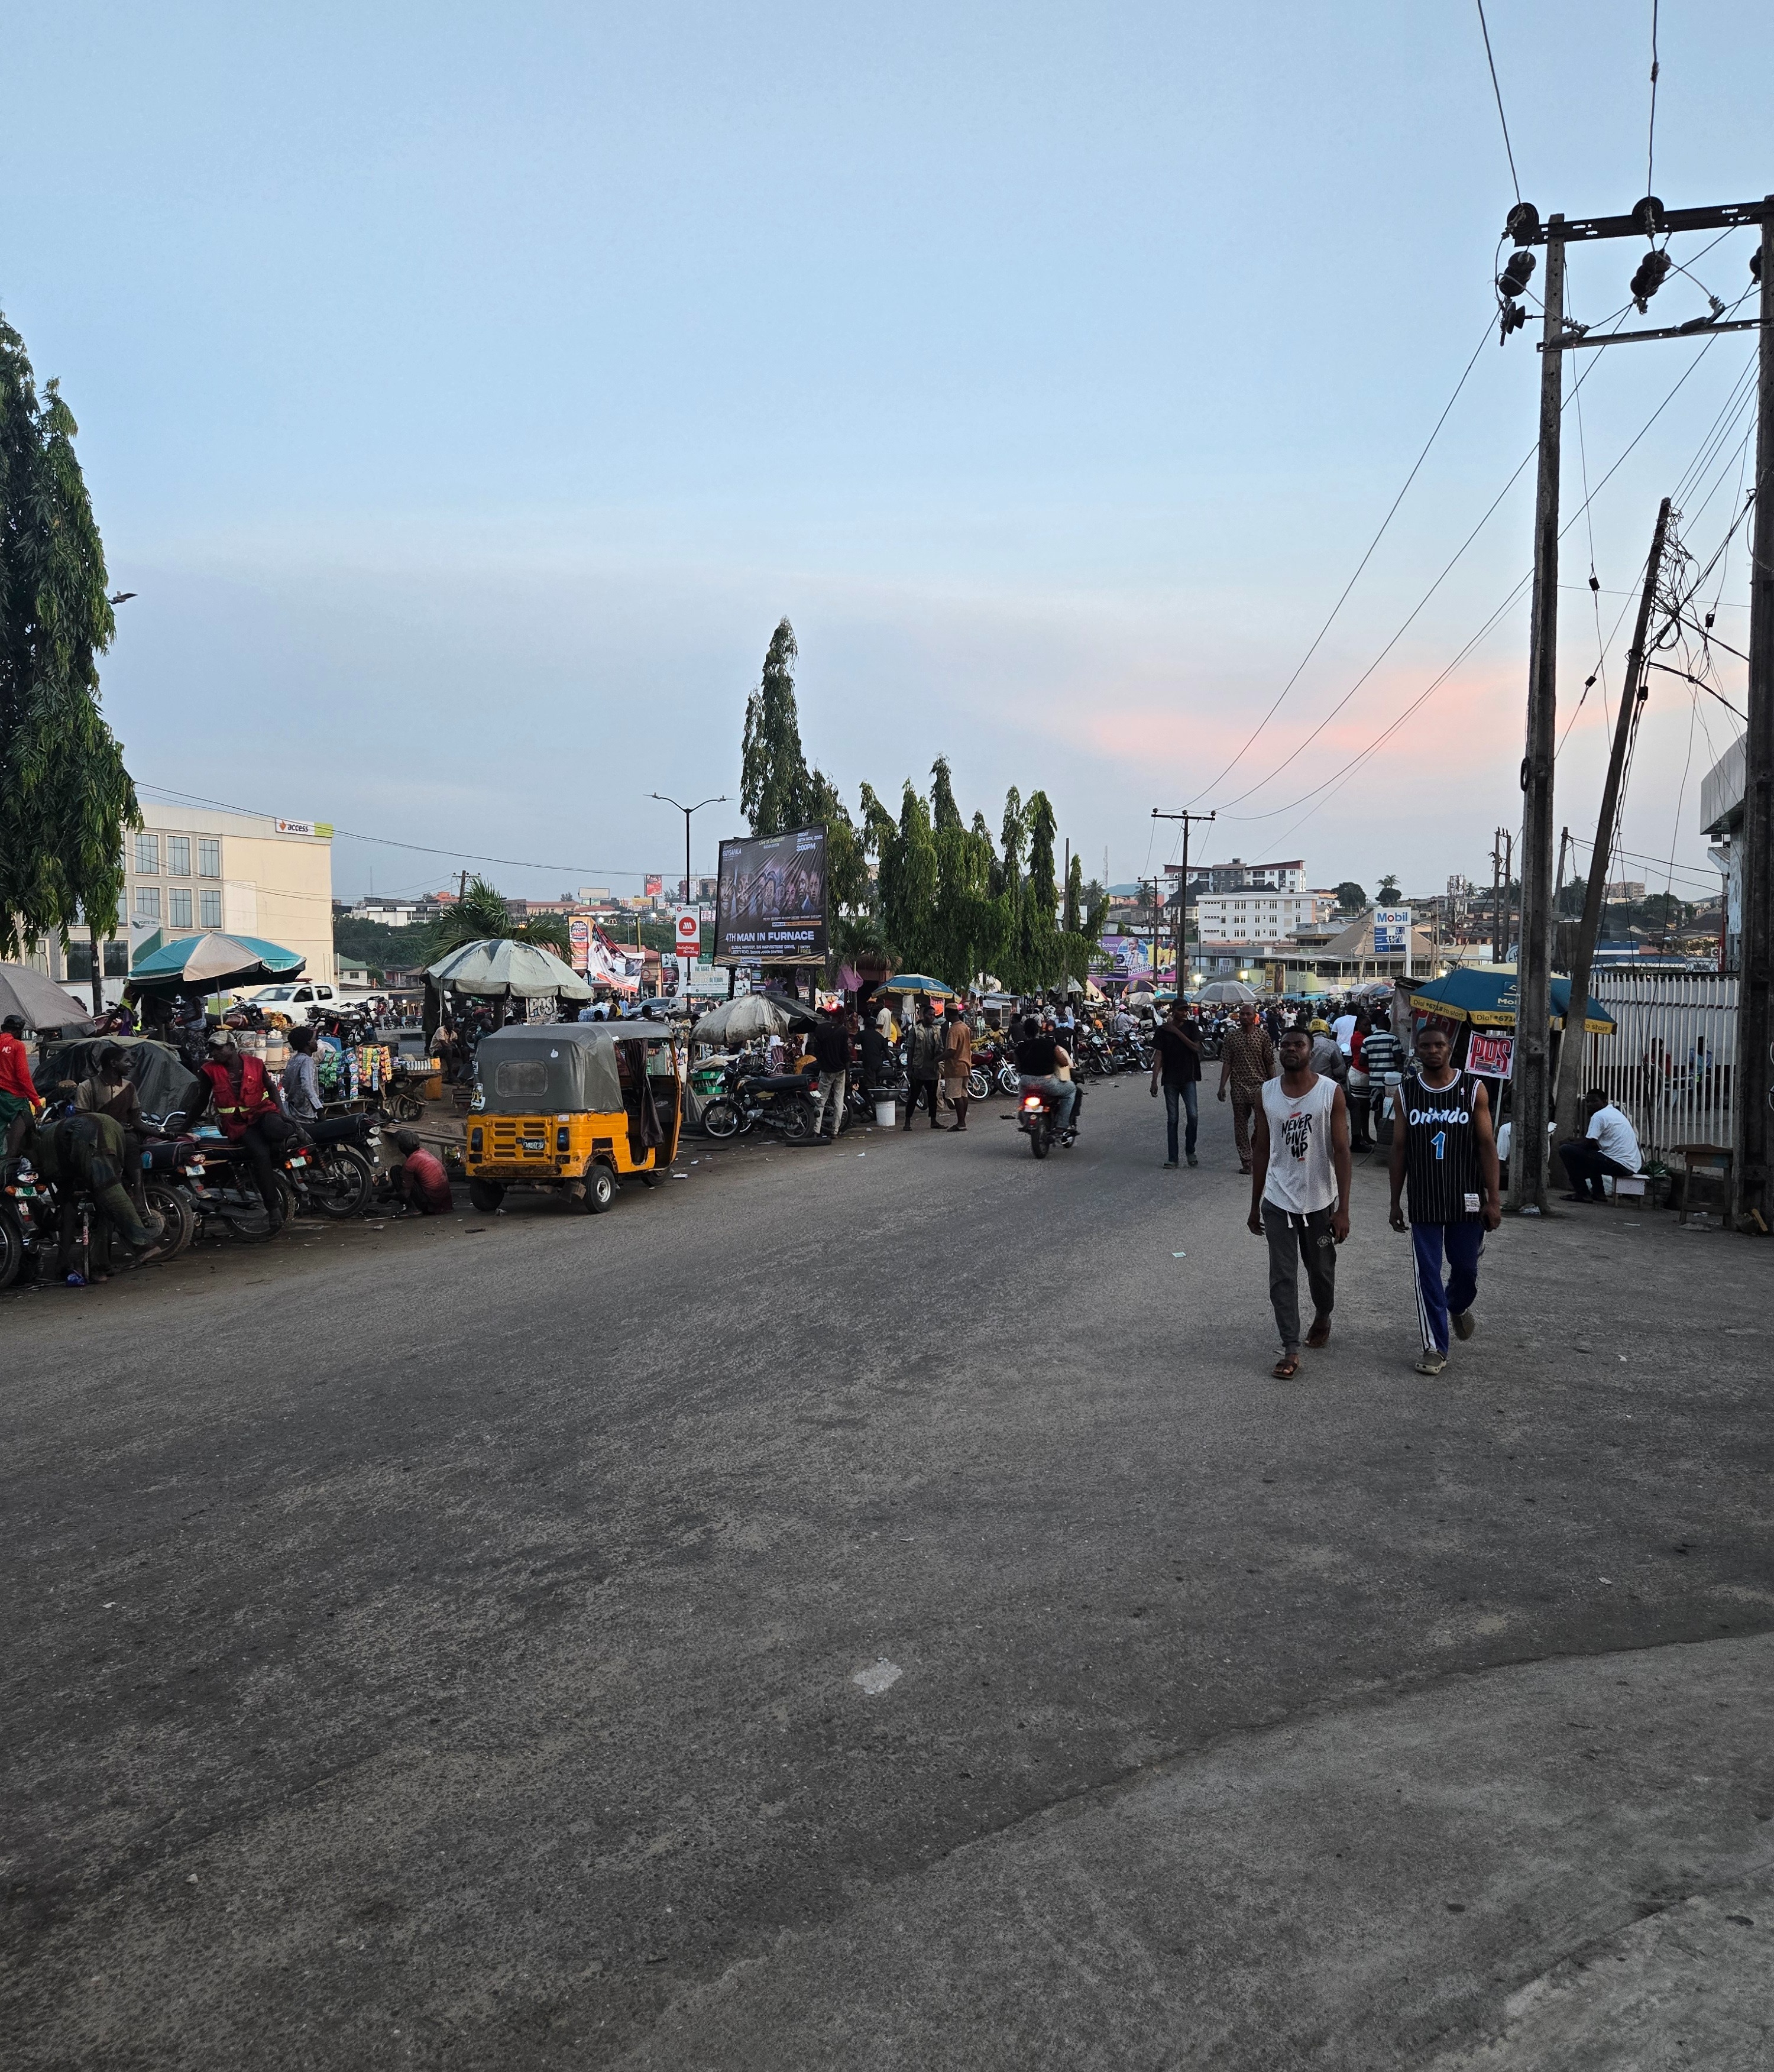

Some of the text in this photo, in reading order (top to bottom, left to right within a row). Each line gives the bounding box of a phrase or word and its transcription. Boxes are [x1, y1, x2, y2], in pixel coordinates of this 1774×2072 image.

[287, 824, 309, 833] access
[796, 843, 816, 852] 3:00PM
[1377, 912, 1407, 922] Mobil
[725, 931, 815, 942] 4TH MAN IN FURNACE
[529, 996, 554, 1016] POS
[1450, 1010, 1464, 1018] start
[1591, 1024, 1608, 1032] start
[1470, 1035, 1511, 1073] POS
[1281, 1113, 1313, 1138] NEVER
[1286, 1128, 1308, 1145] GIVE
[1291, 1142, 1309, 1158] UP
[1430, 1131, 1446, 1160] 1
